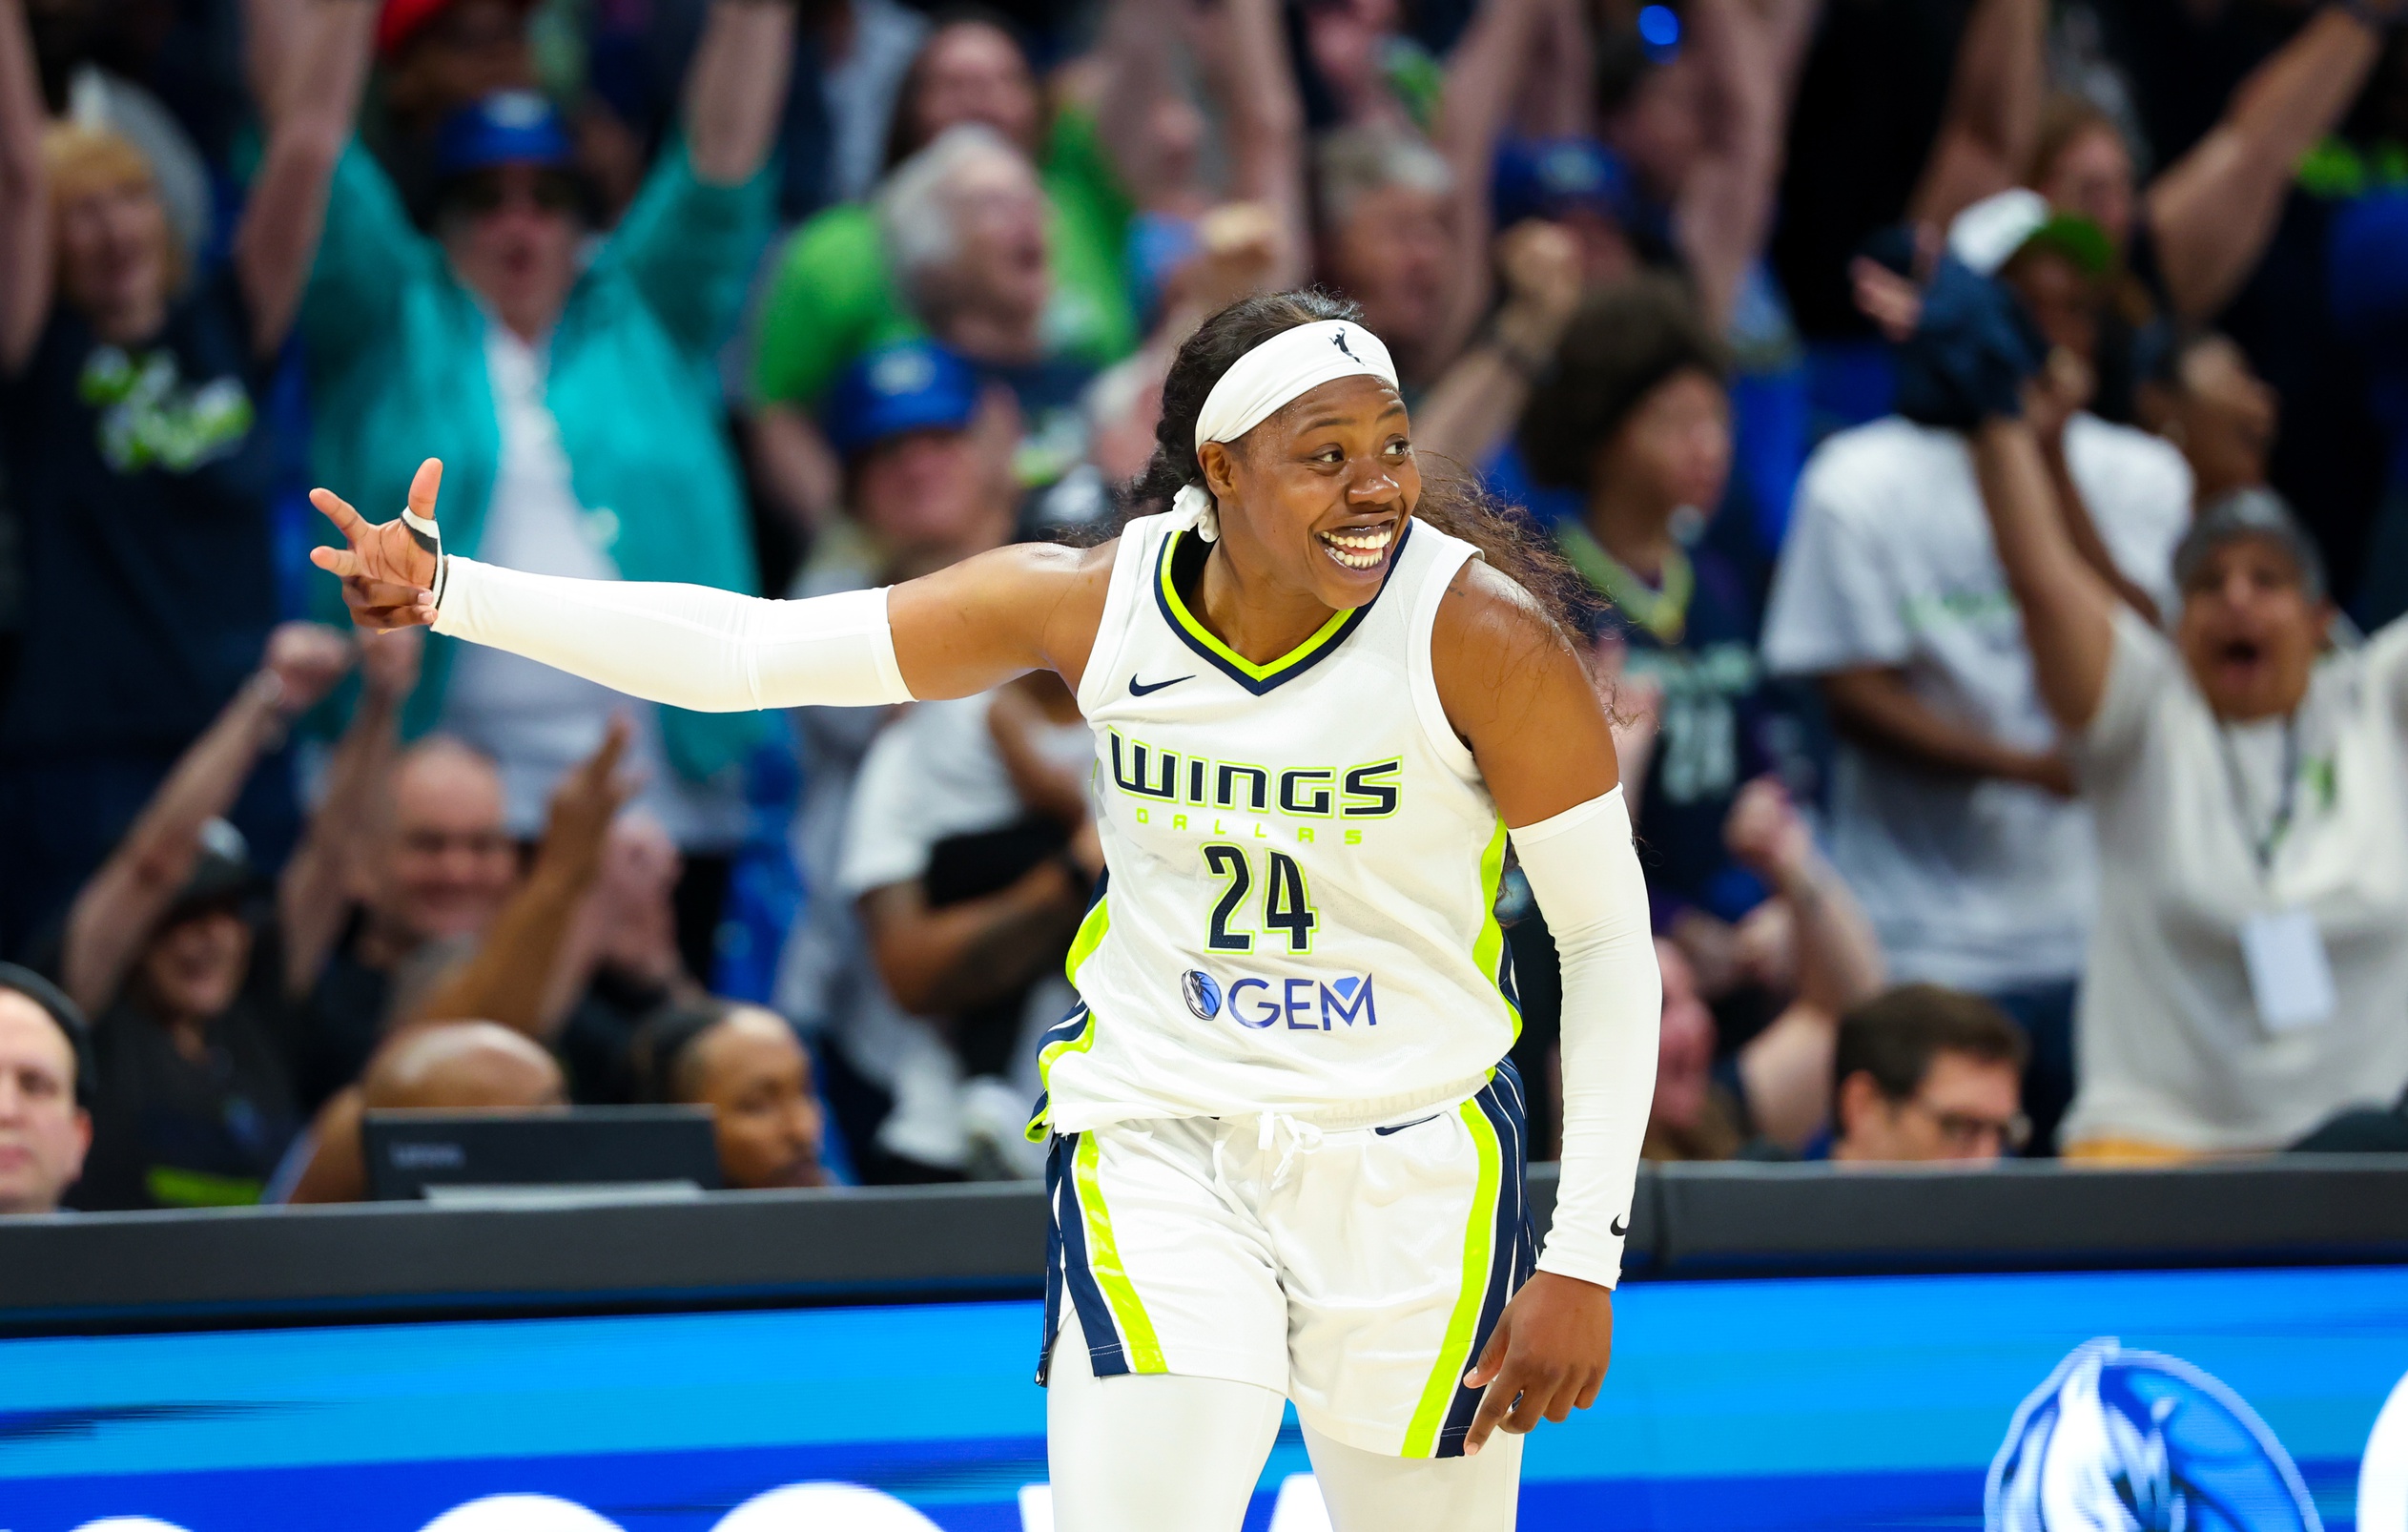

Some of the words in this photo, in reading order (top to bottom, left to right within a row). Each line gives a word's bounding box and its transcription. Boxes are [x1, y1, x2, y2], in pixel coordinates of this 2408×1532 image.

[1108, 725, 1403, 820] WINGS
[1137, 808, 1362, 845] DALLAS
[1200, 841, 1319, 955] 24
[1226, 972, 1377, 1031] GEM
